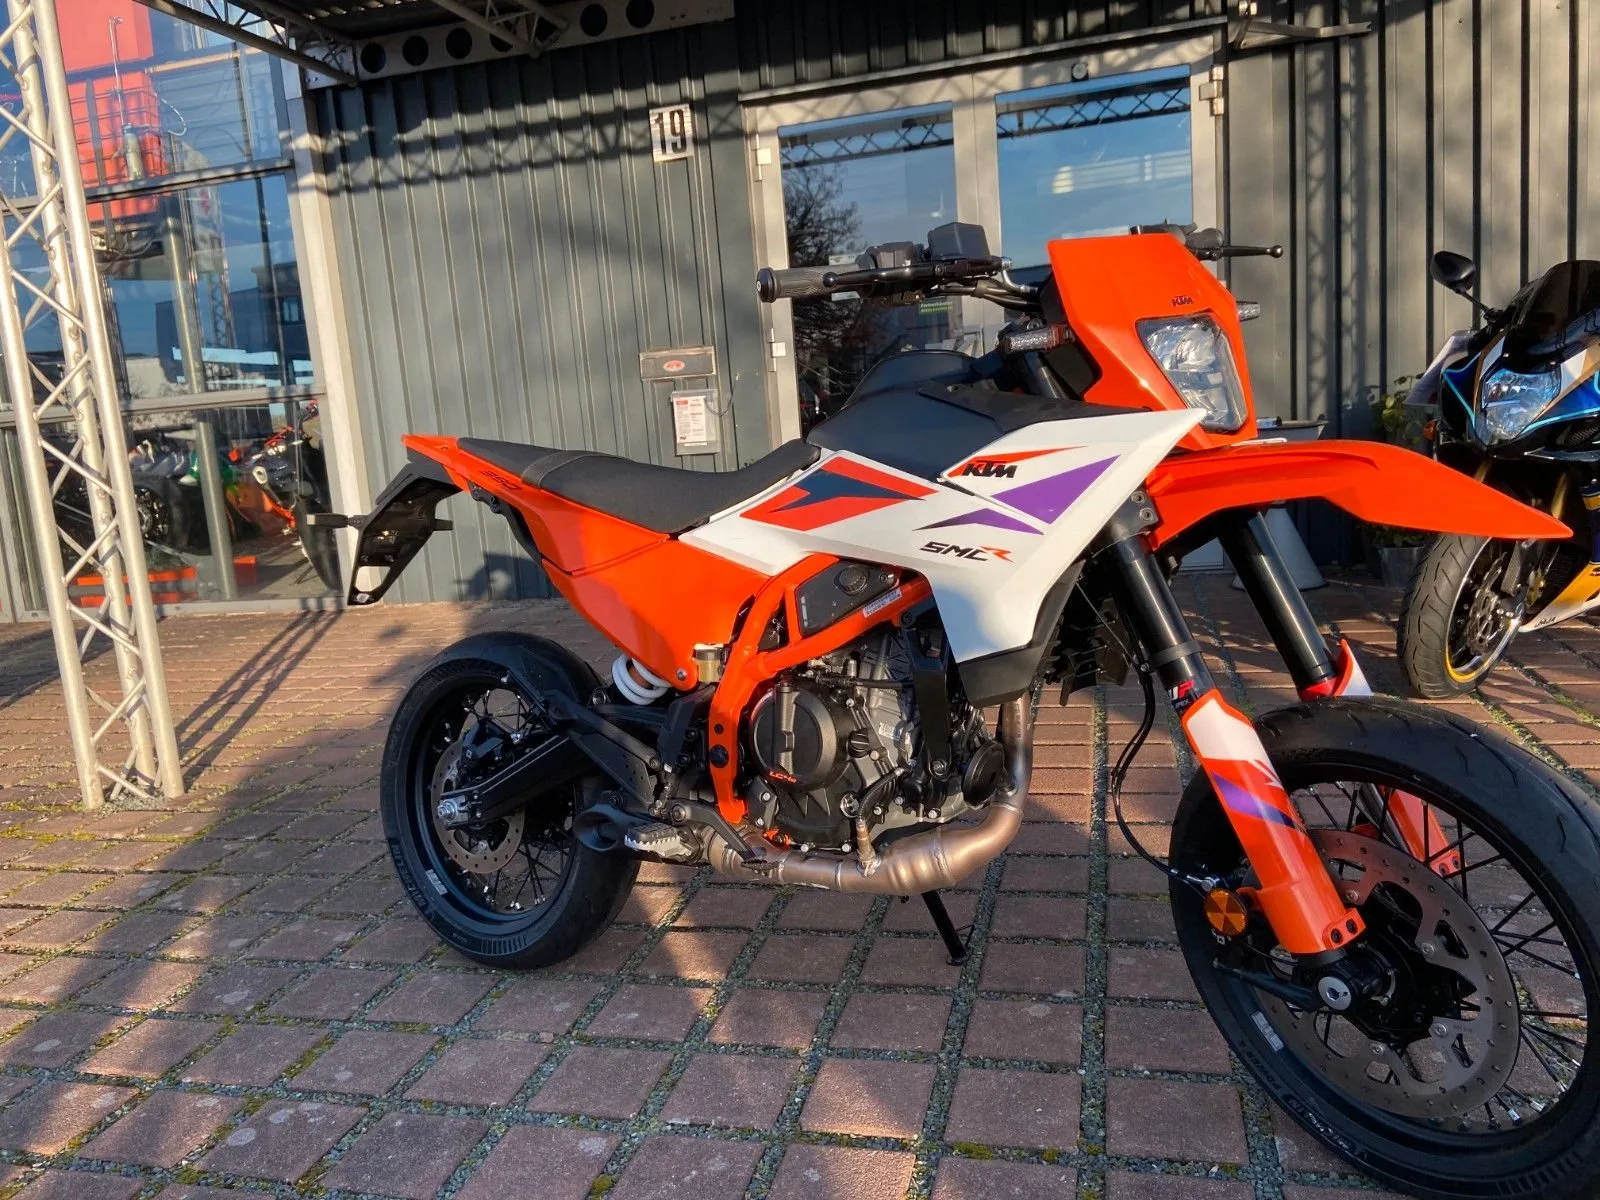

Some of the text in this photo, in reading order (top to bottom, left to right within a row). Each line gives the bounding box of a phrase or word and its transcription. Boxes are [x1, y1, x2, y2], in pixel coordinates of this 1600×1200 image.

[654, 109, 687, 155] 19
[1171, 295, 1193, 307] KTM
[962, 460, 1018, 479] KTM
